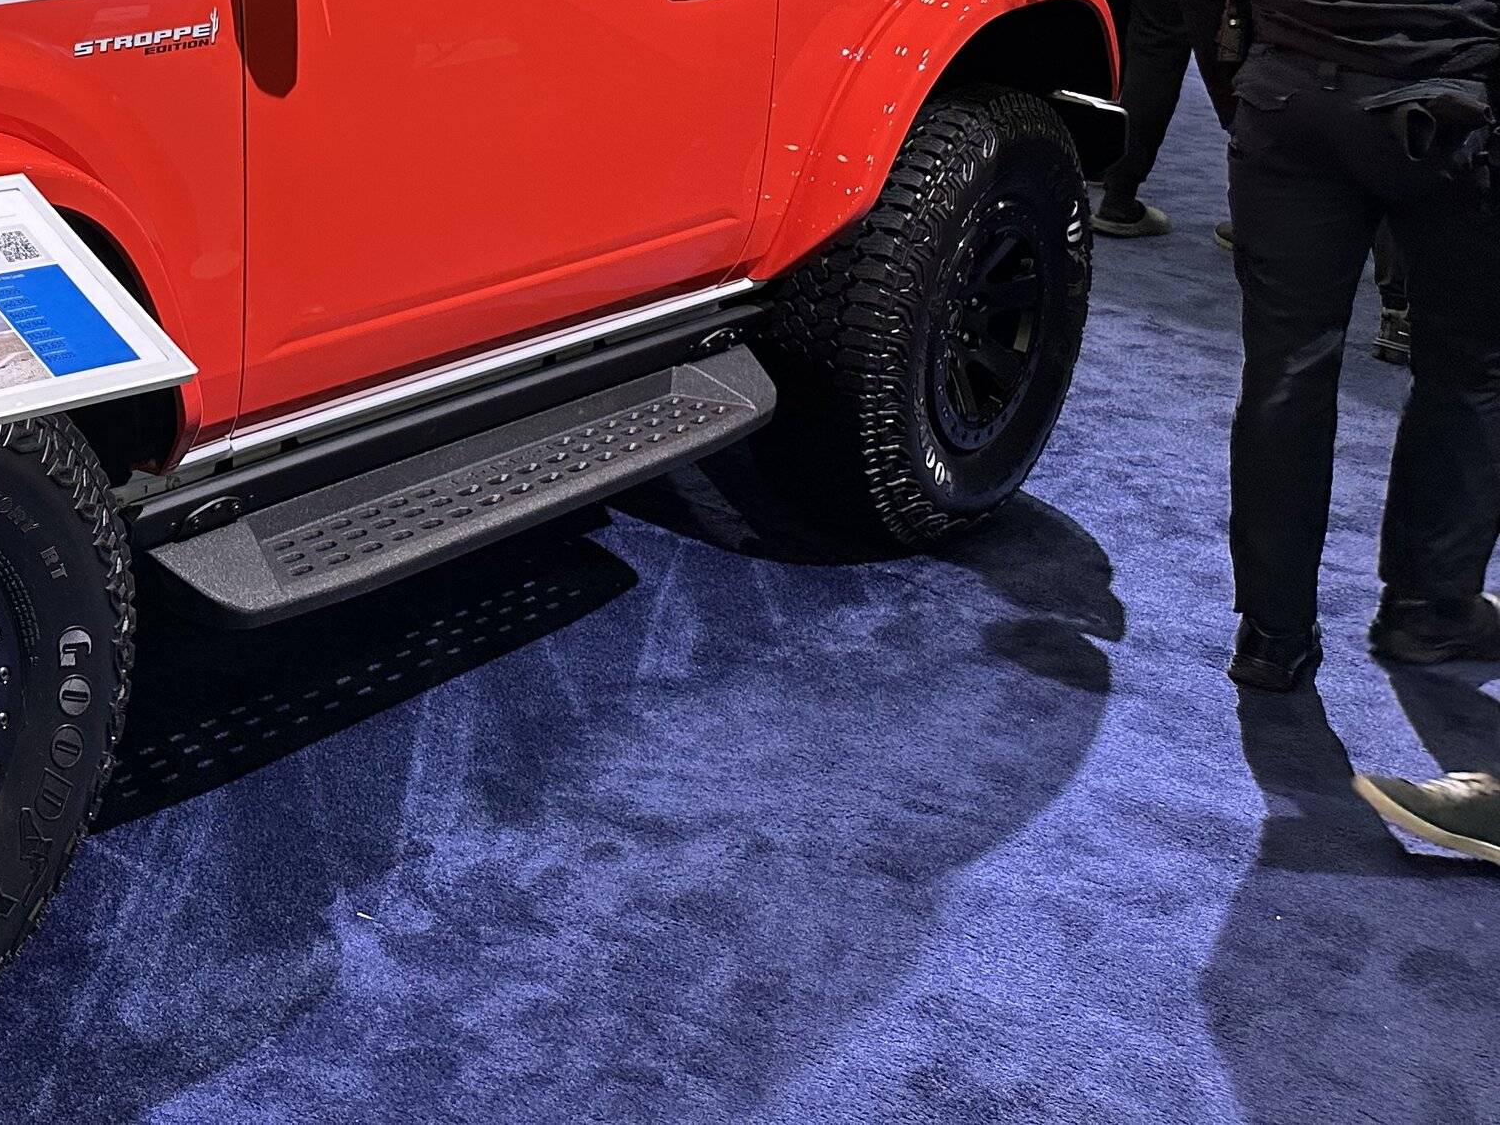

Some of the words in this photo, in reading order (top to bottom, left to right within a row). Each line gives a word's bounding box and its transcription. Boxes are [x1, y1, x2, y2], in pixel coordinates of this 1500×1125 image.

[73, 23, 211, 57] STROPPE
[144, 38, 210, 56] EDITION
[40, 546, 68, 579] RT
